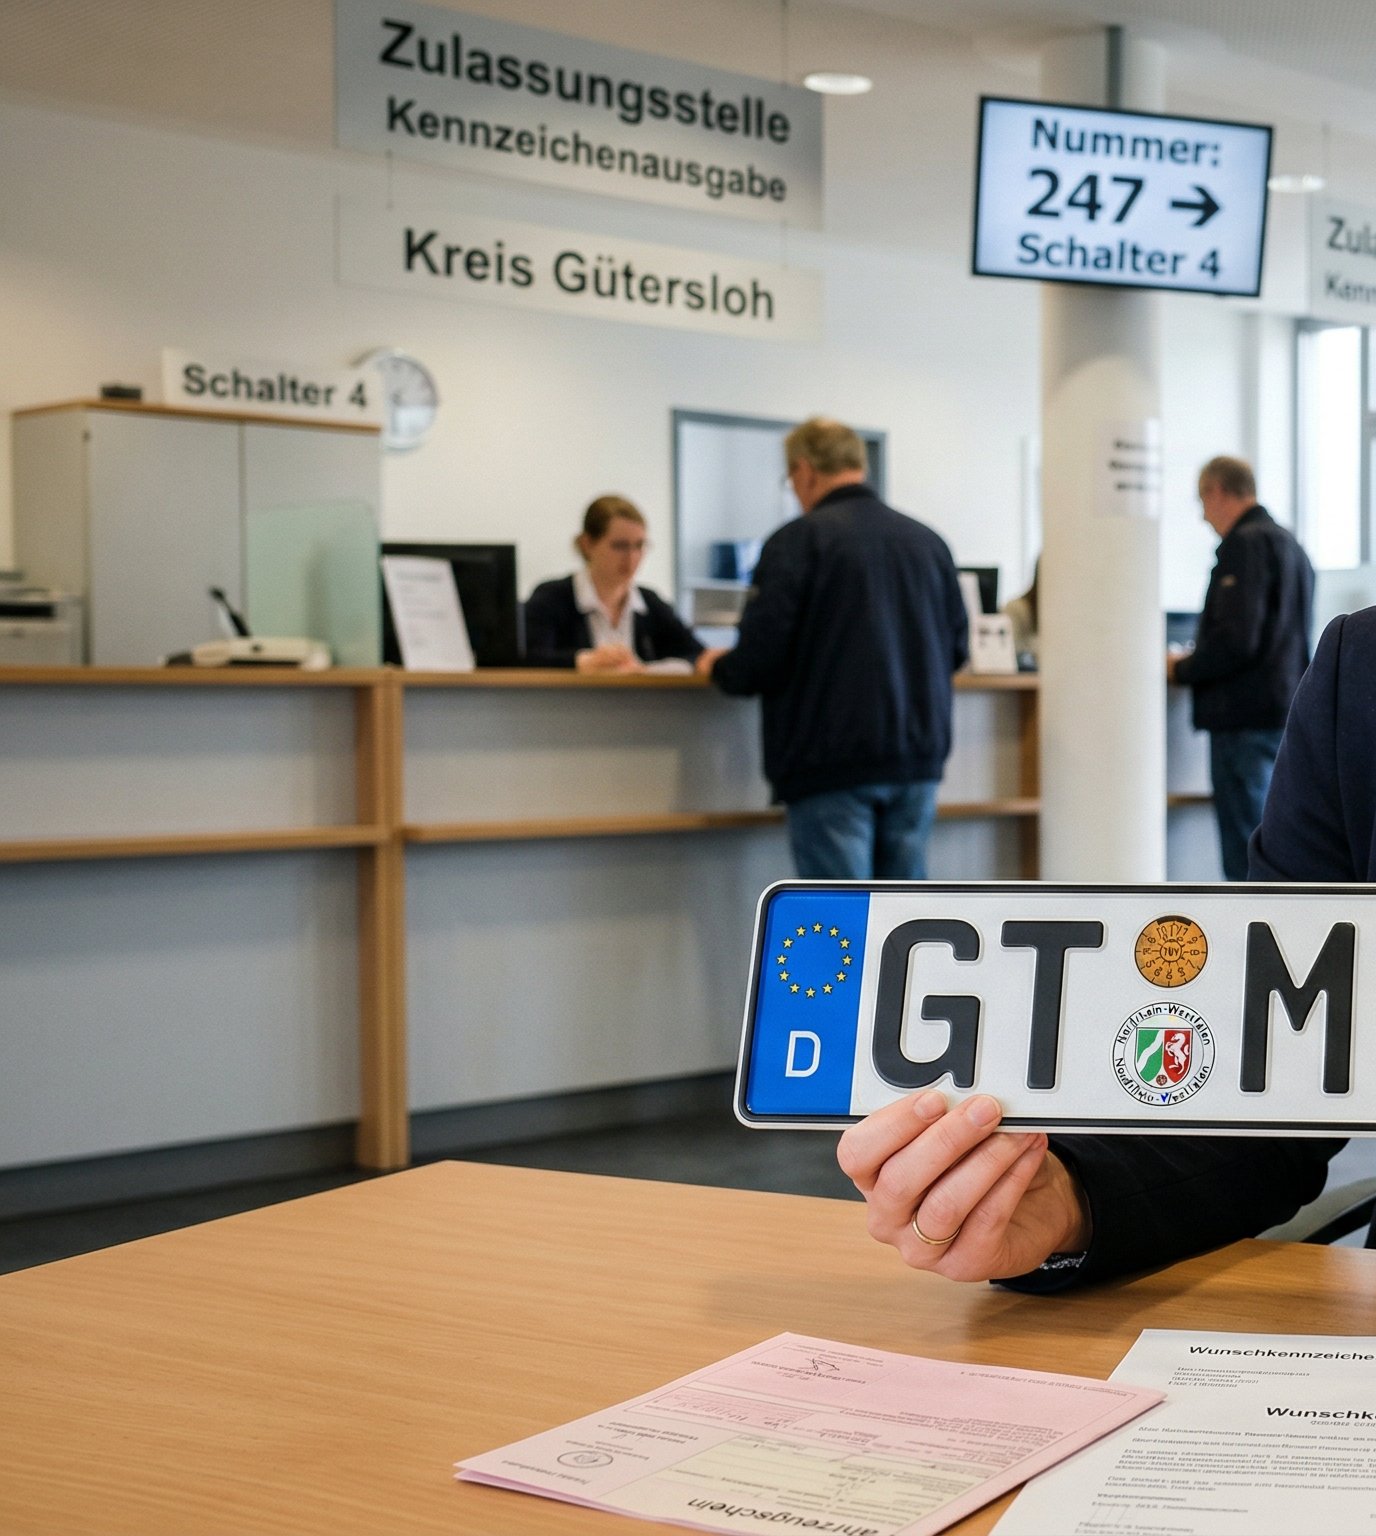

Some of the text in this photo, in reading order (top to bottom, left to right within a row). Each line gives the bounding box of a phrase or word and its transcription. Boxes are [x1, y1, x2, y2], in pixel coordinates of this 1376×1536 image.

[380, 19, 791, 143] Zulassungsstelle
[387, 97, 787, 202] Kennzeichenausgabe
[1031, 118, 1221, 167] Nummer:
[1027, 169, 1145, 224] 247
[404, 228, 775, 320] Kreis Gütersloh
[1017, 233, 1222, 280] Schalter 4
[183, 363, 367, 408] Schalter 4
[873, 919, 1104, 1090] GT
[1240, 921, 1356, 1094] M
[785, 1030, 821, 1078] D
[687, 1497, 897, 1536] ahrzeugschein
